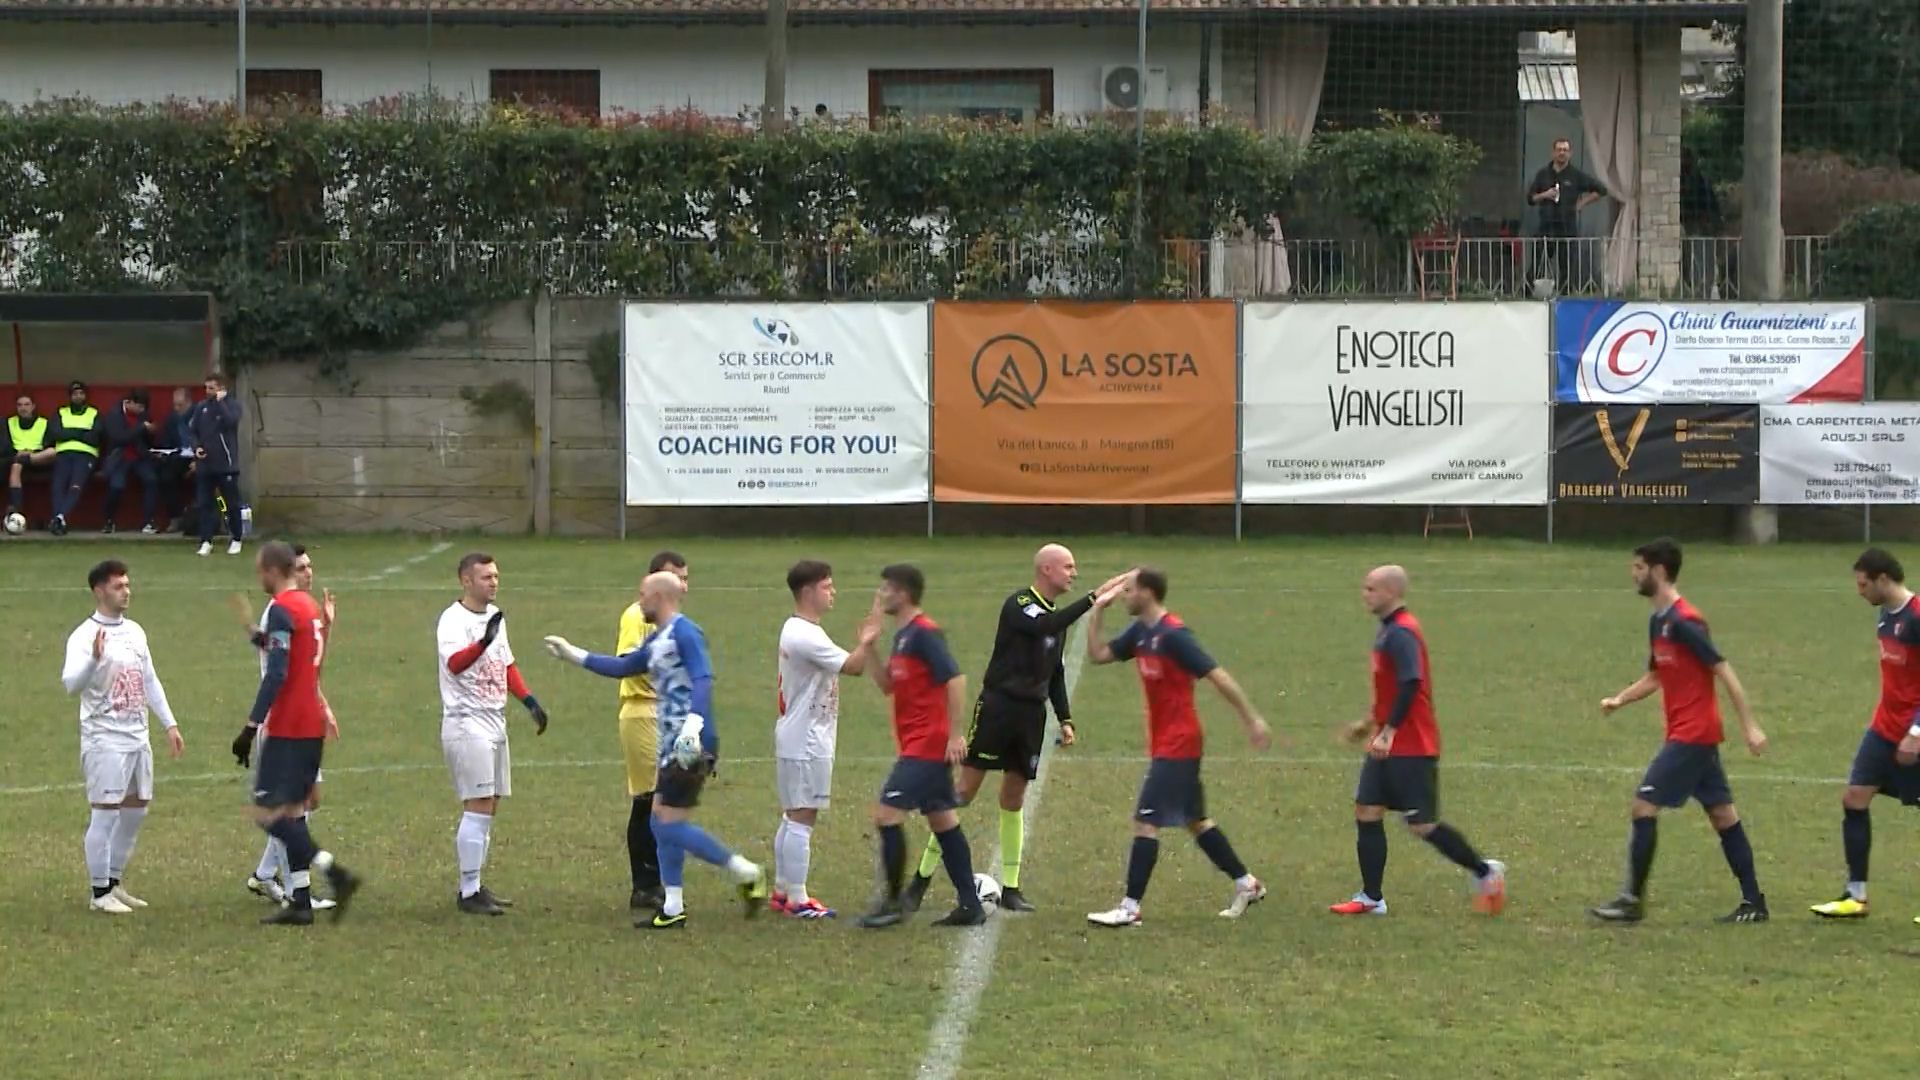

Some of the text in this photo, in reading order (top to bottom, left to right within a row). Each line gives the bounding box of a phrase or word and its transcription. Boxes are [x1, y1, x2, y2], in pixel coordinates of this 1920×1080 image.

[1669, 311, 1717, 330] Chini
[1720, 311, 1829, 330] Guarnizioni
[1608, 329, 1657, 376] C
[719, 352, 835, 367] SCR SERCOM.R
[1729, 354, 1743, 364] Tel.
[1062, 353, 1199, 377] LA SOSTA
[753, 373, 766, 382] per
[778, 371, 826, 380] Commercio
[1099, 383, 1163, 392] ACTIVEWEAR
[1763, 417, 1792, 426] CMA
[1797, 417, 1887, 426] CARPENTERIA
[1872, 433, 1905, 442] SRLS
[658, 434, 897, 455] COACHING FOR YOU!
[997, 440, 1014, 450] Via
[1018, 439, 1035, 450] del
[1043, 463, 1151, 474] LaSostaActivewear
[1266, 459, 1319, 468] TELEFONO
[1331, 459, 1386, 468] WHATSAPP
[1448, 459, 1465, 468] VIA
[1468, 459, 1498, 468] ROMA
[1478, 473, 1523, 481] CAMUNO
[1805, 490, 1831, 500] Darfo
